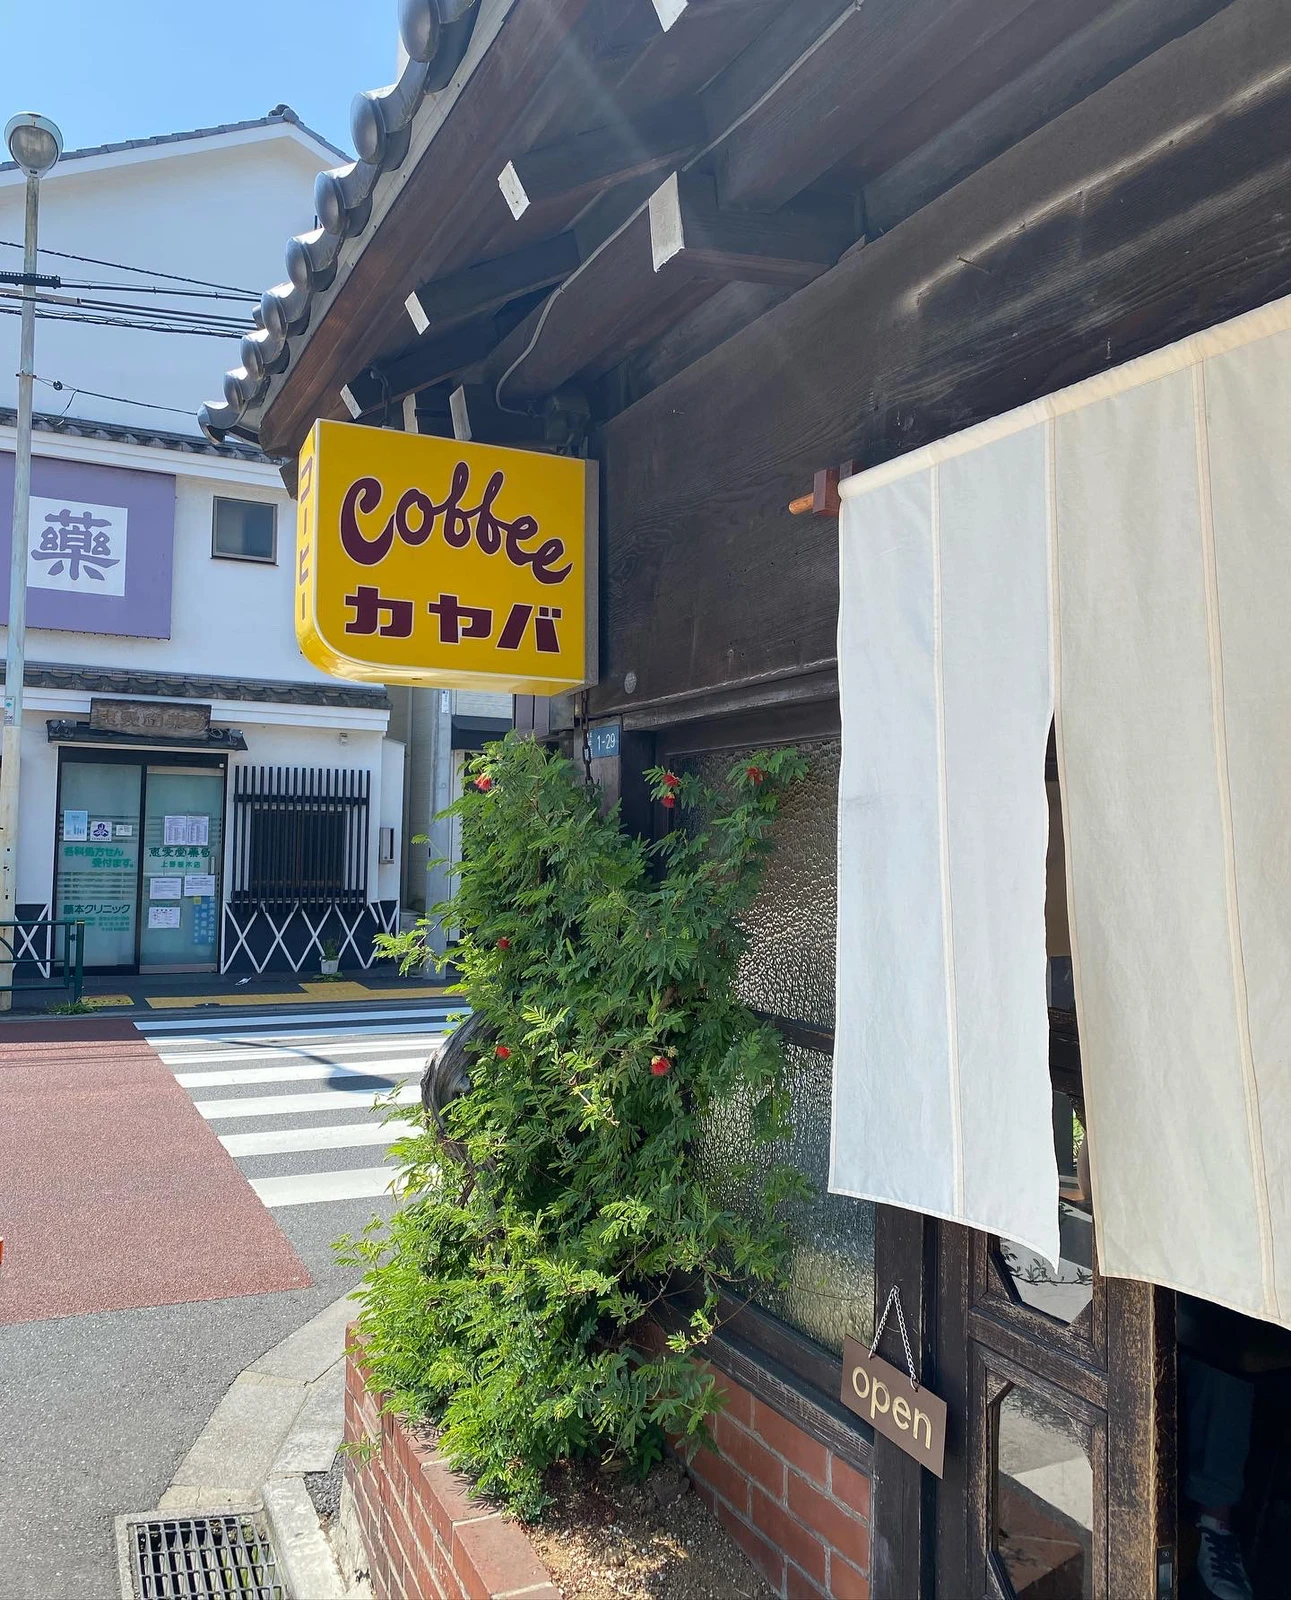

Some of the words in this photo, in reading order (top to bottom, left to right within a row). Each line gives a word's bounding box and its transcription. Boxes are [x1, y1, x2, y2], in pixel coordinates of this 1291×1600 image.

[300, 456, 313, 621] コーヒー
[339, 460, 574, 585] Coffee
[344, 585, 563, 654] カヤバ
[597, 733, 616, 751] 1-29
[91, 858, 134, 868] 受付ます。
[852, 1366, 932, 1449] open
